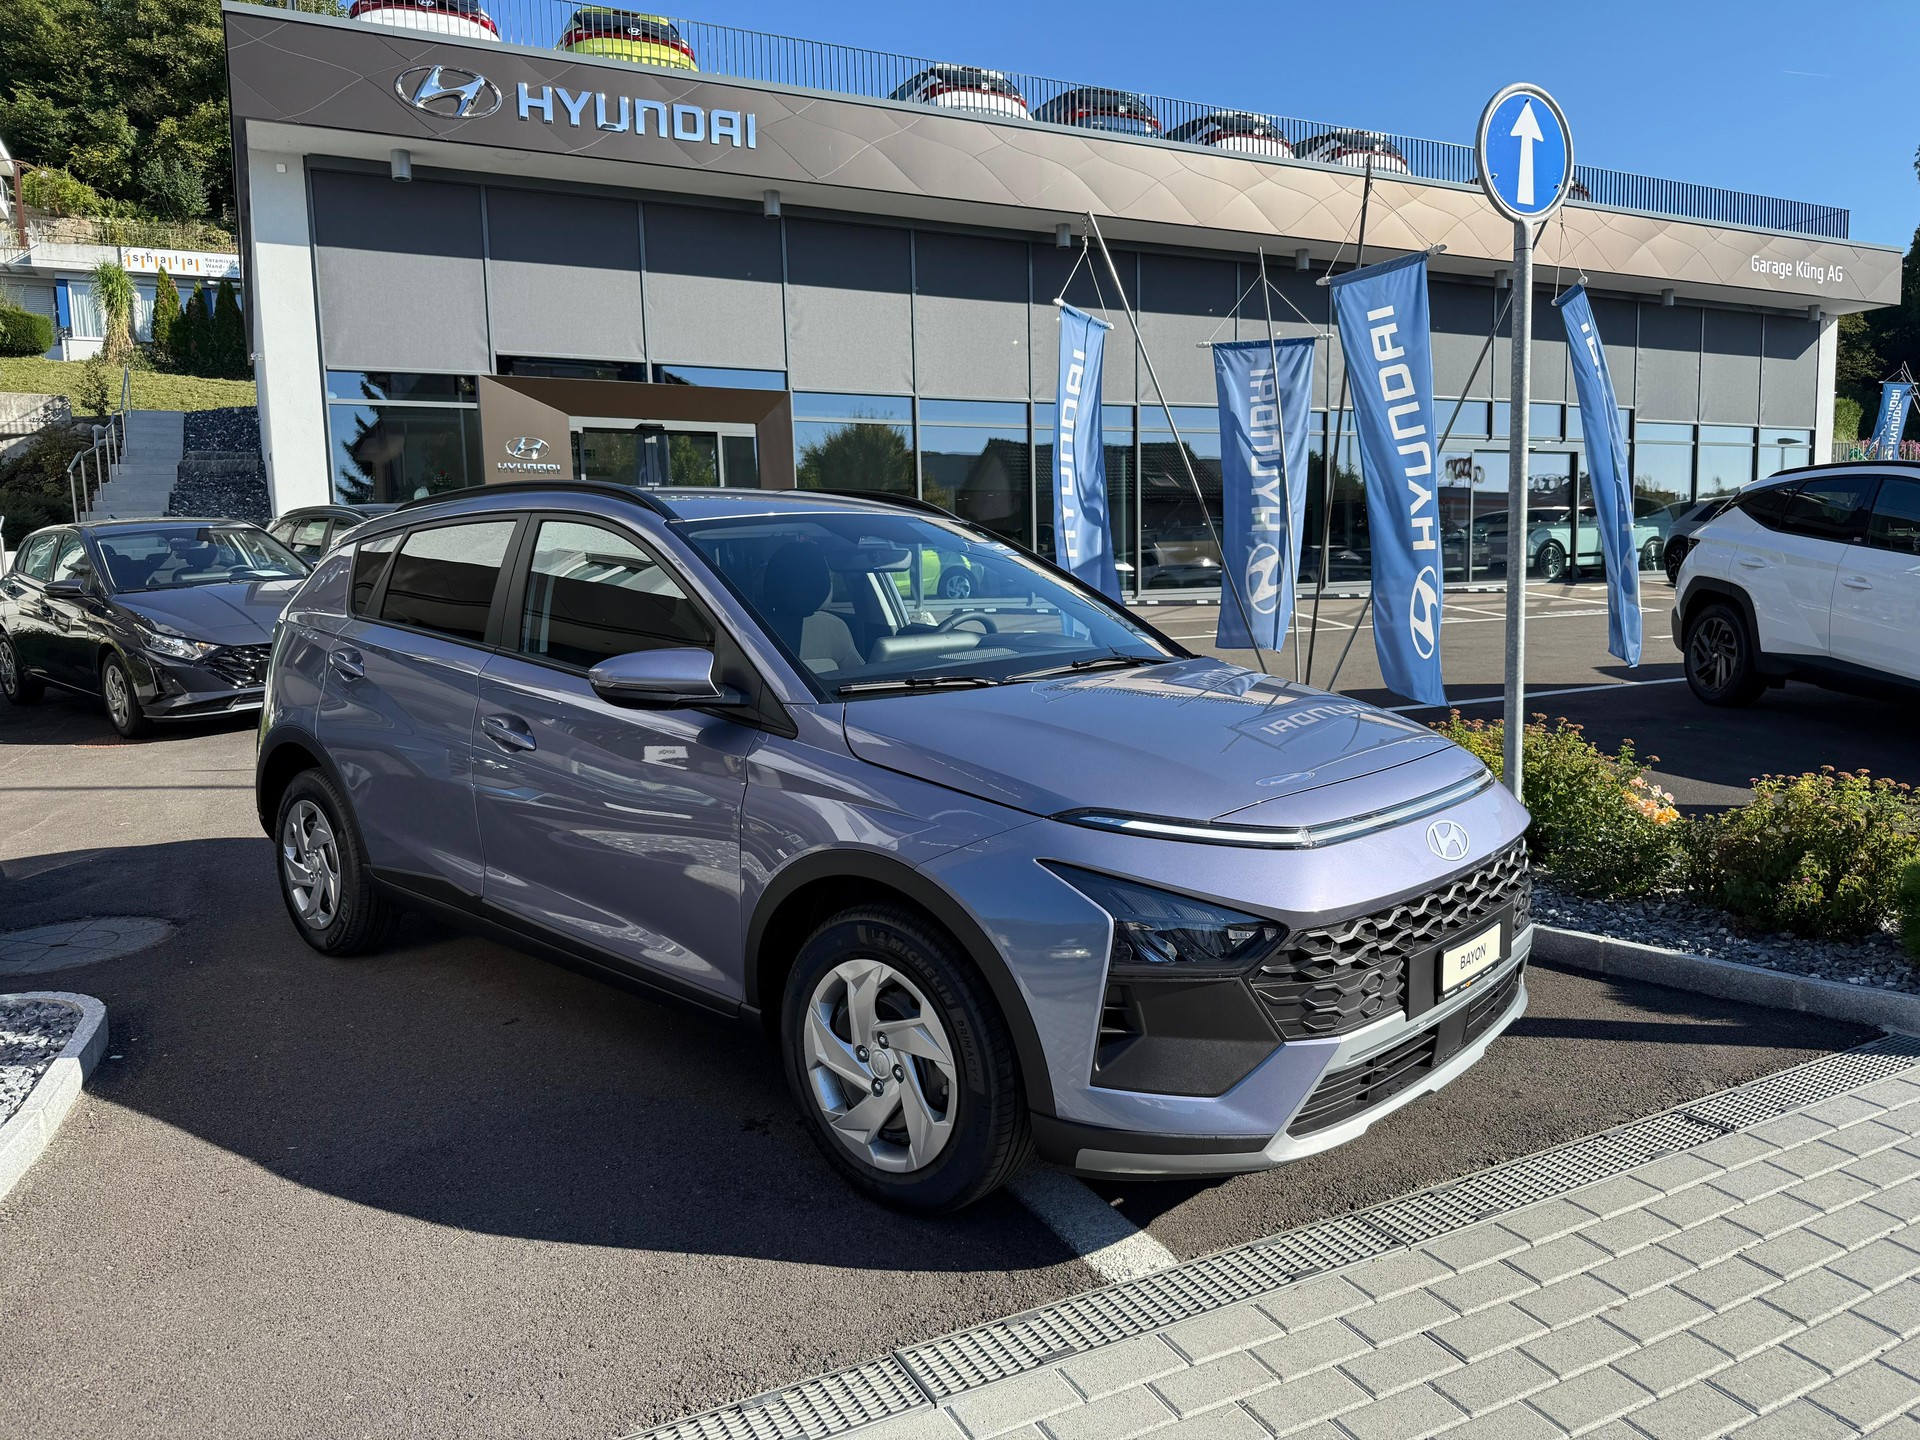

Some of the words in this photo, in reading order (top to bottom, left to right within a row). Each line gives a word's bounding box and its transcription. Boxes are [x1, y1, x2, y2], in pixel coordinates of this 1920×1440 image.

[517, 82, 756, 149] HYUNDAI
[1751, 255, 1792, 279] Garage
[1796, 260, 1824, 284] Küng
[1827, 265, 1843, 282] AG
[1367, 305, 1437, 550] HYUNDAI
[497, 462, 561, 475] HYUNDAI
[888, 937, 956, 1006] MICHELIN
[1460, 943, 1487, 970] BAYON
[957, 1020, 978, 1076] PRIMACY
